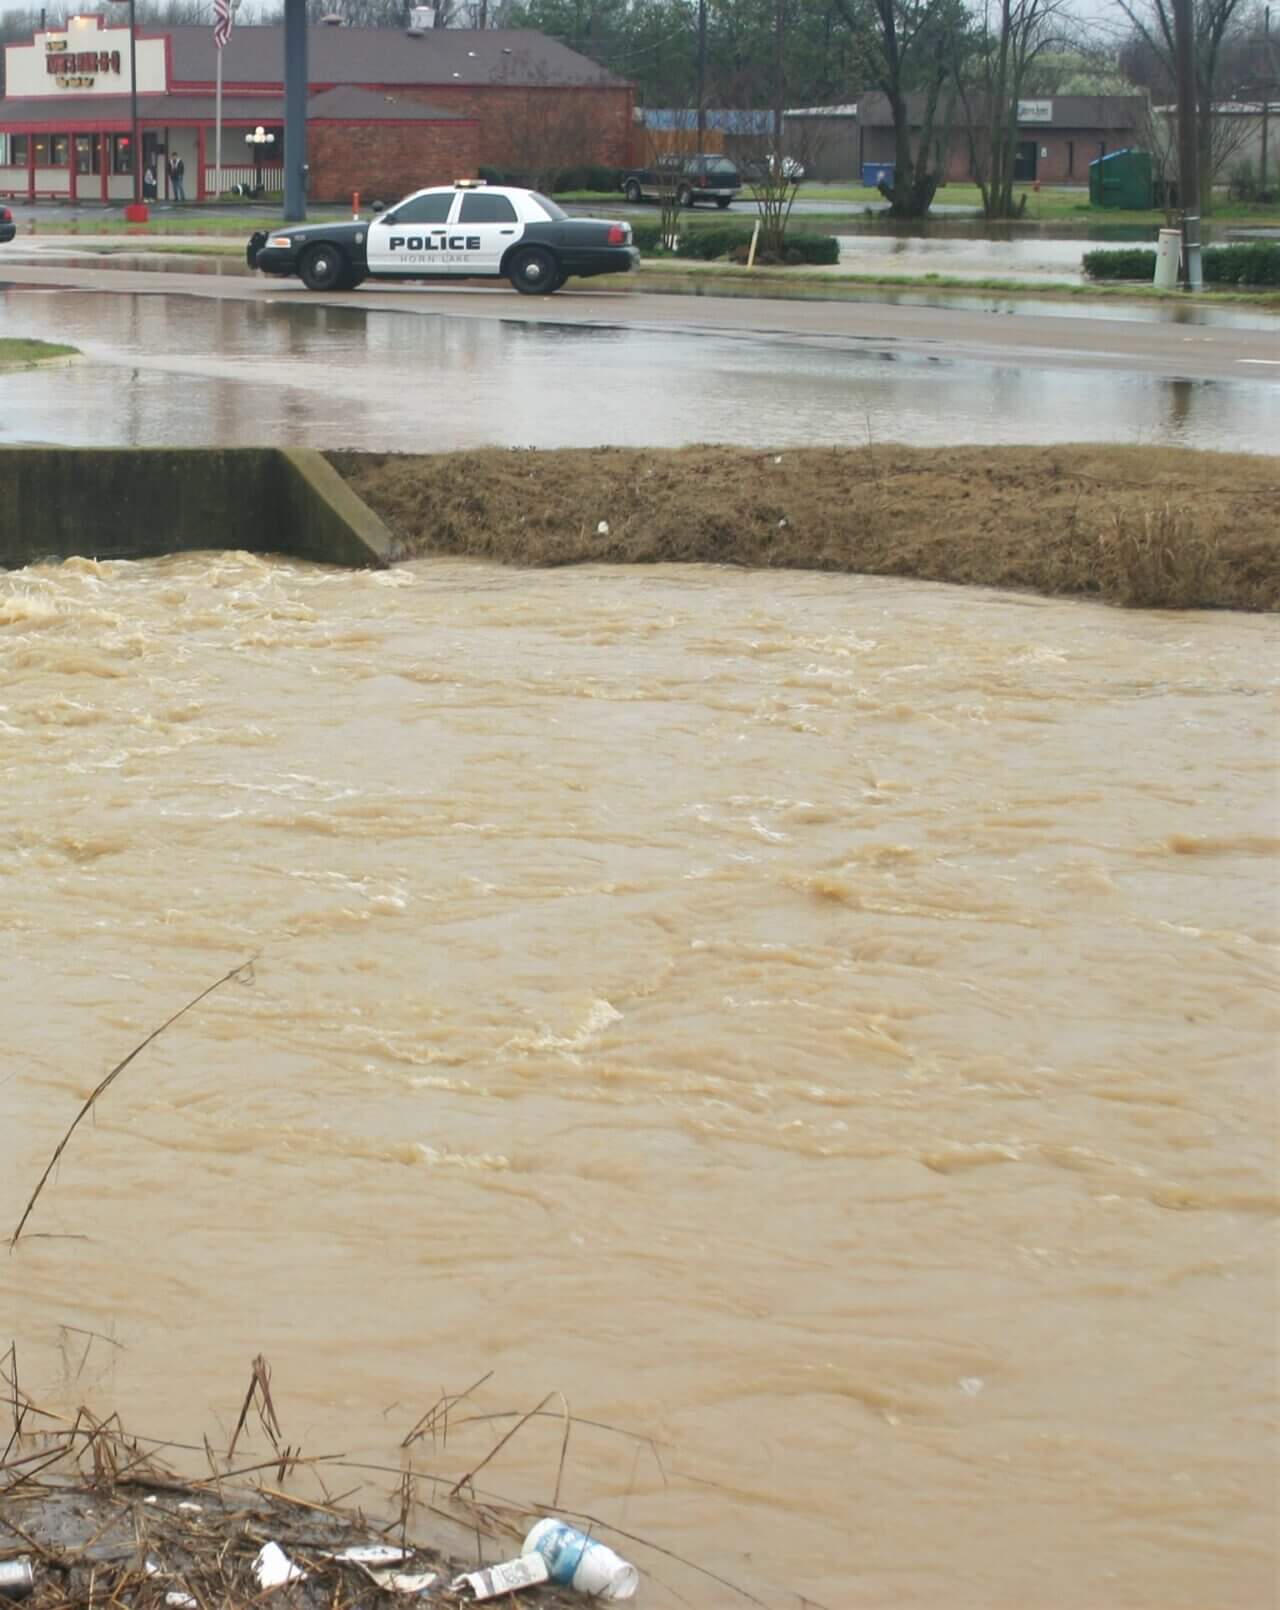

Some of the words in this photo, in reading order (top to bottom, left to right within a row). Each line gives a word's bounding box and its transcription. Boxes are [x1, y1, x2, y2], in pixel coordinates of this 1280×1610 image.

[389, 237, 480, 250] POLICE
[400, 255, 435, 263] HORN
[441, 255, 470, 263] LAKE
